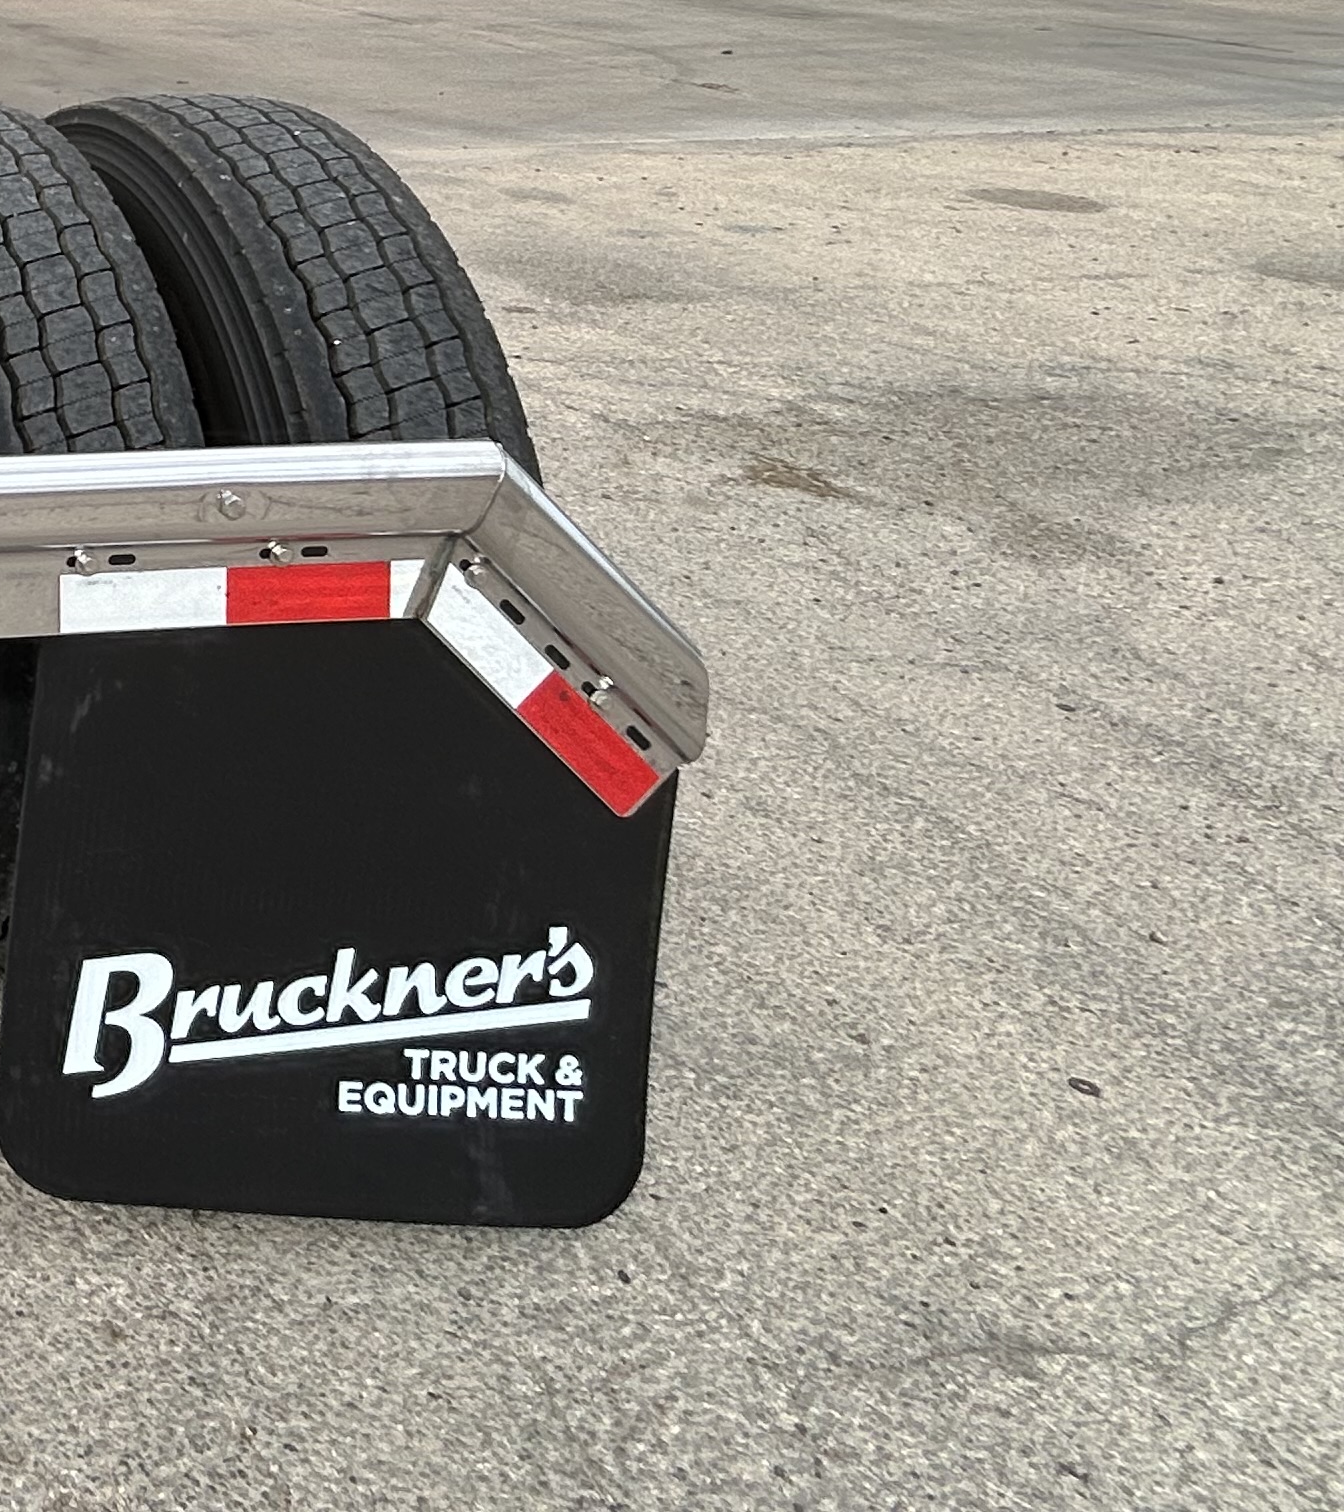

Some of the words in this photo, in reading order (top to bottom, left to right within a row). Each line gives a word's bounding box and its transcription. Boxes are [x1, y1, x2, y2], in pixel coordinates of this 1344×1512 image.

[63, 926, 594, 1099] Bruckner's
[403, 1048, 546, 1086] TRUCK
[554, 1054, 583, 1086] &
[338, 1080, 584, 1123] EQUIPMENT
